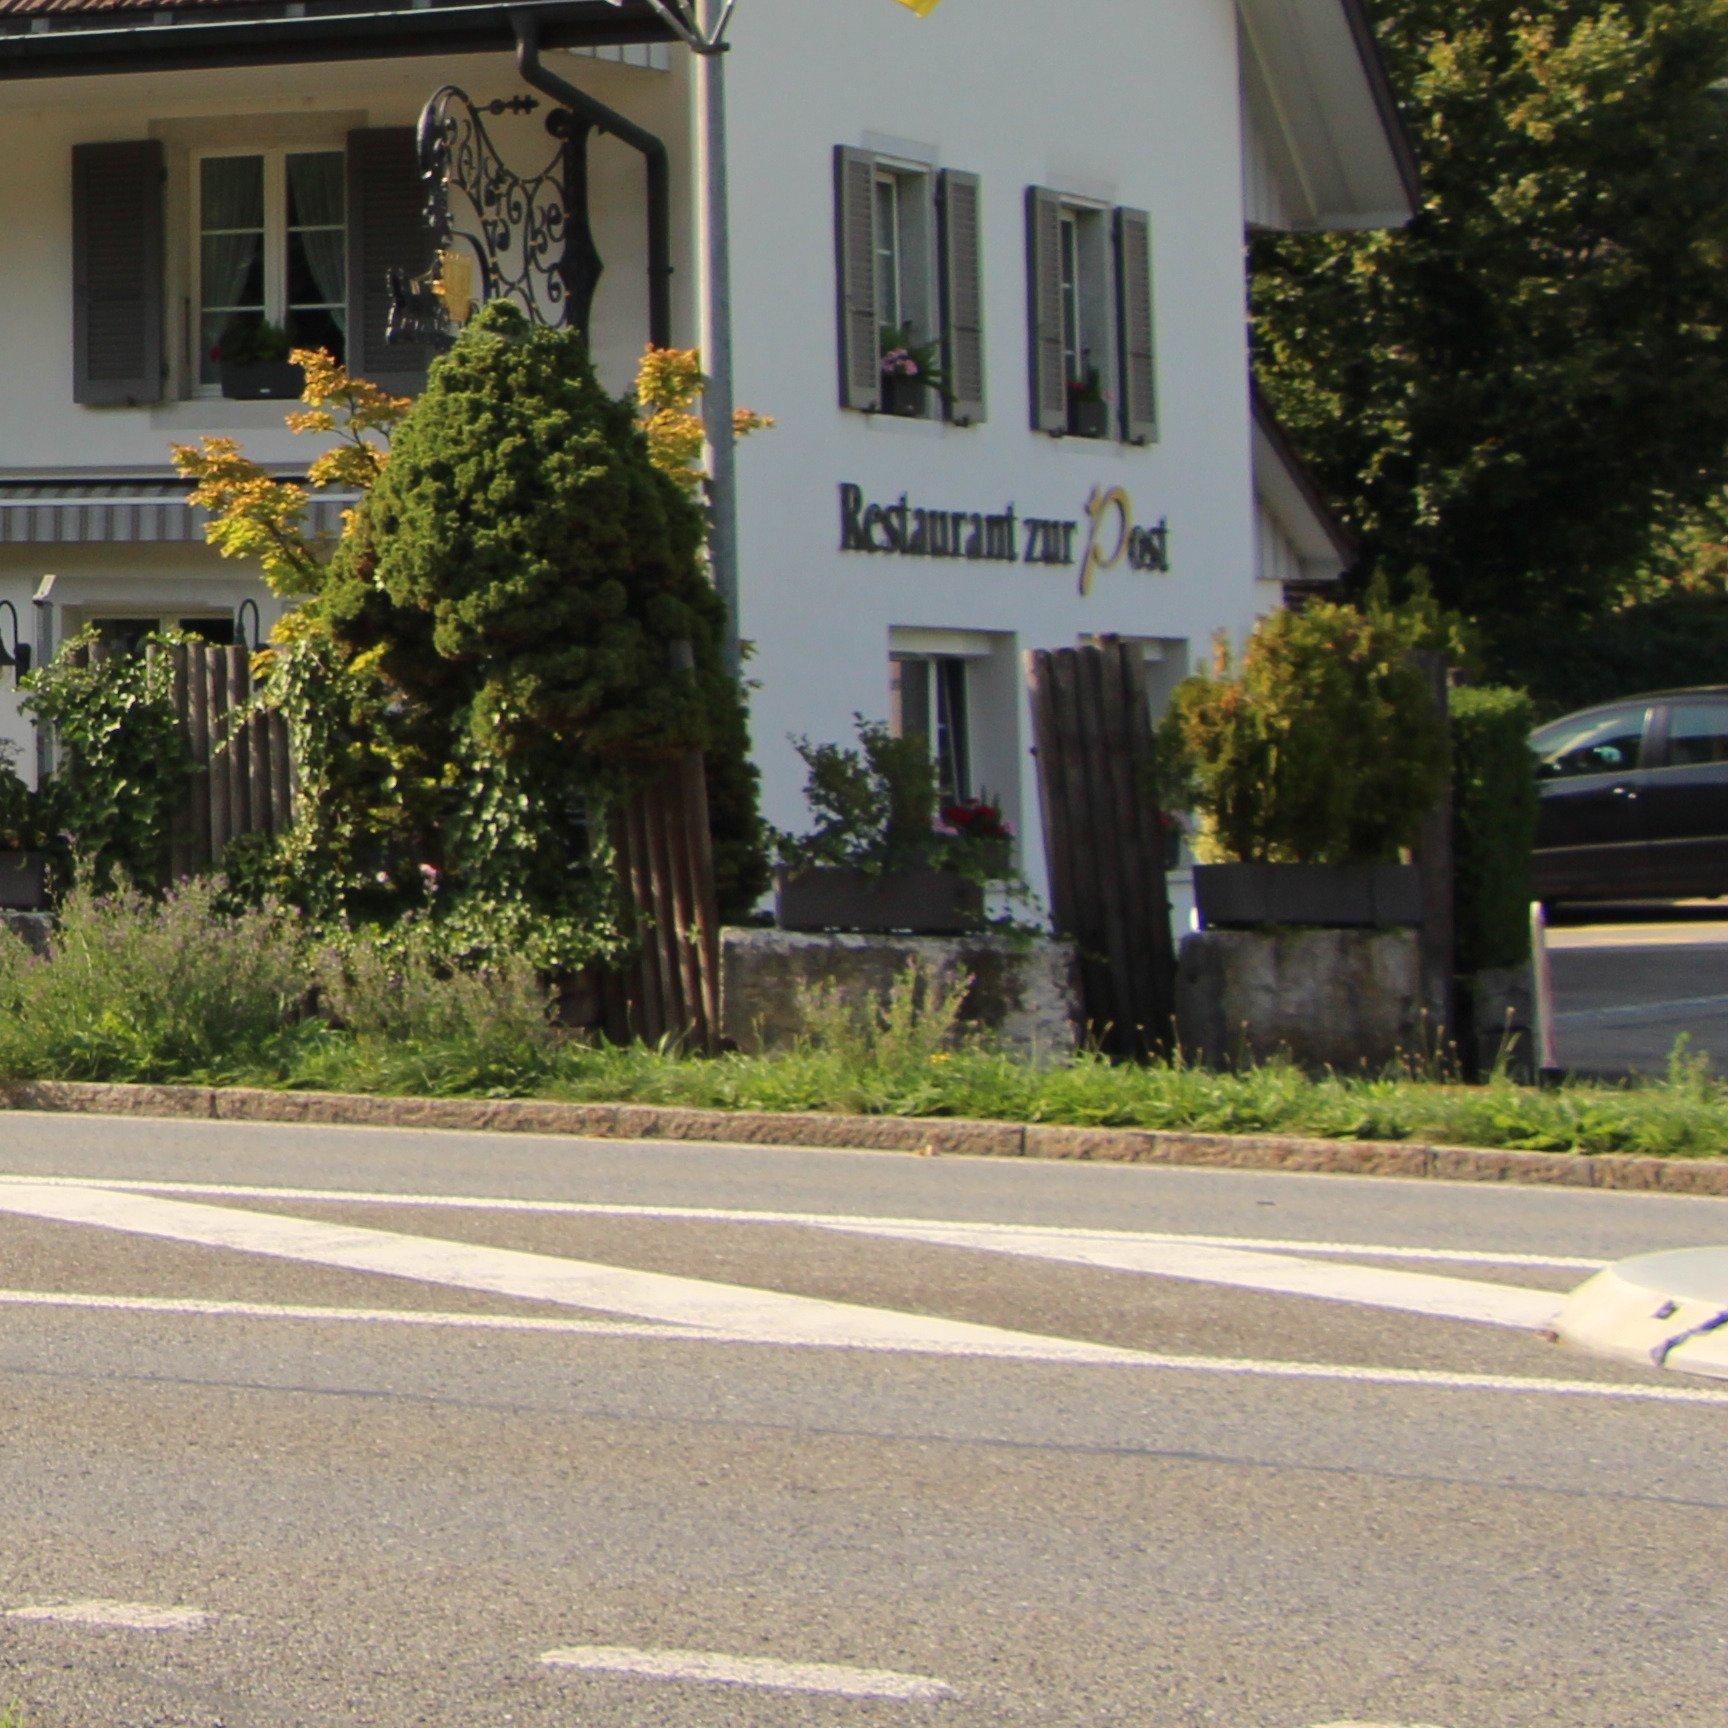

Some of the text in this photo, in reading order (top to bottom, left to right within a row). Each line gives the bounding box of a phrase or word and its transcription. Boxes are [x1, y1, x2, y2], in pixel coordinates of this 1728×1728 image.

[839, 482, 1168, 596] Restaurant zur Post
